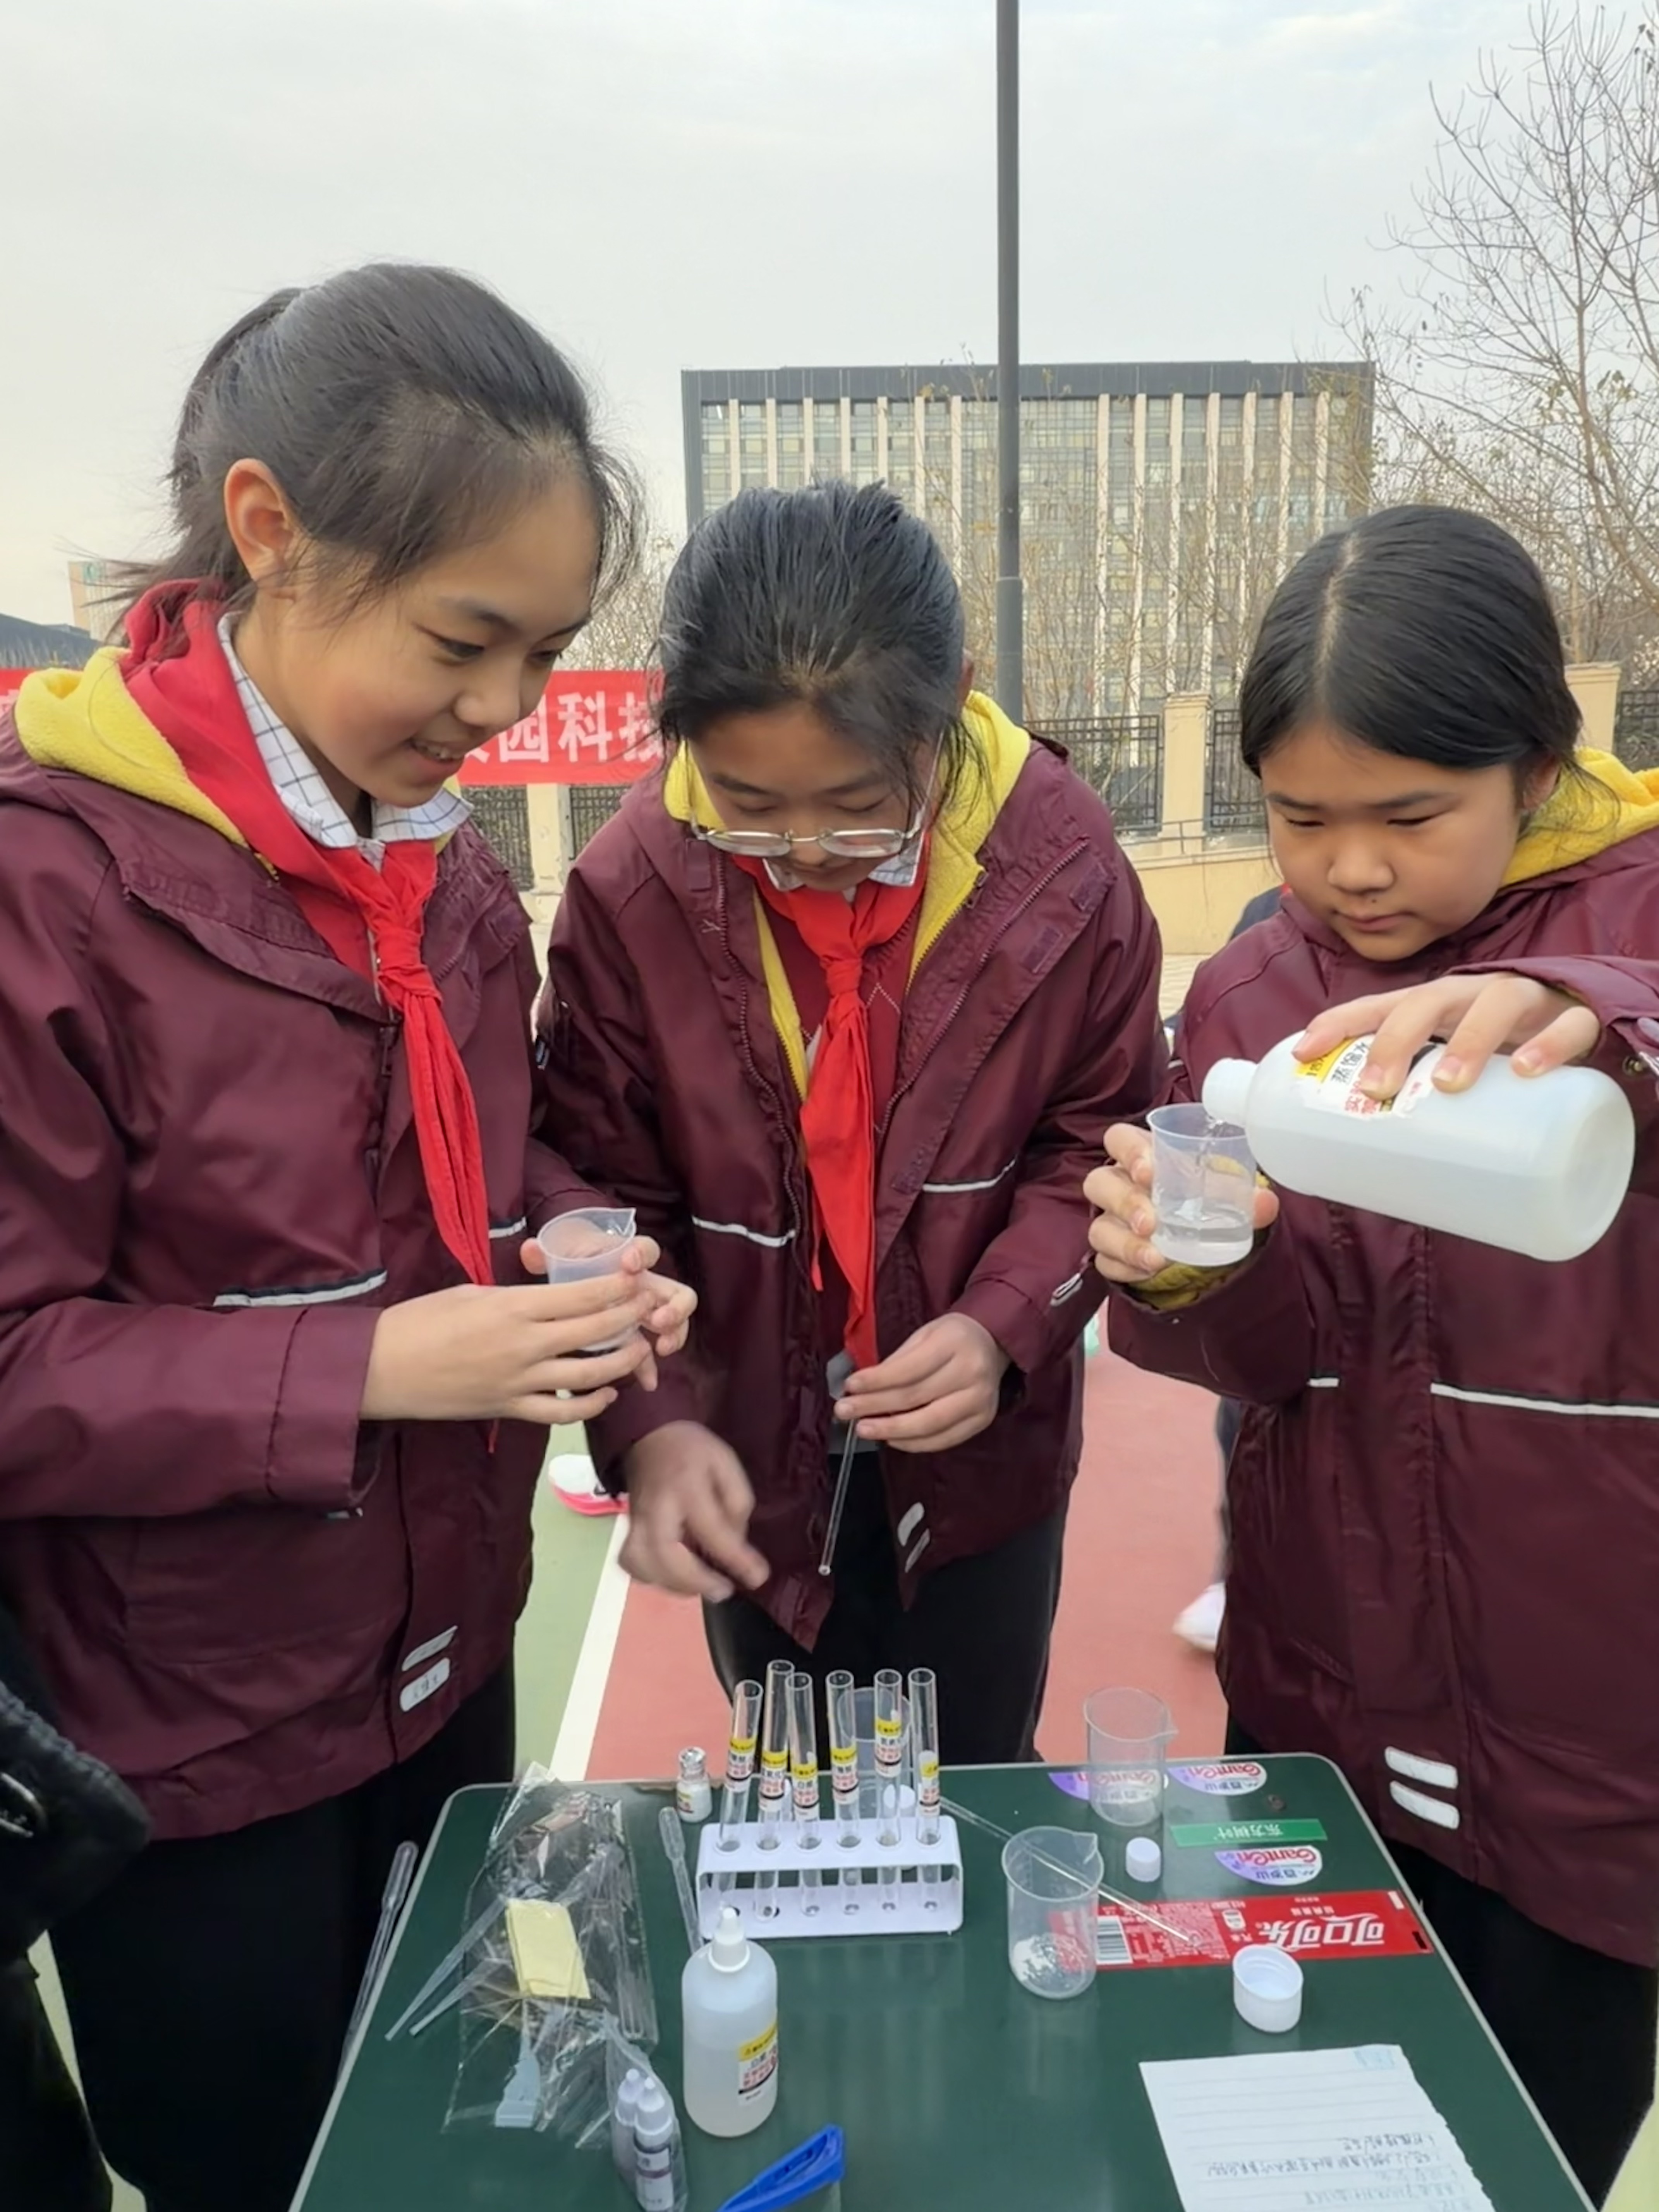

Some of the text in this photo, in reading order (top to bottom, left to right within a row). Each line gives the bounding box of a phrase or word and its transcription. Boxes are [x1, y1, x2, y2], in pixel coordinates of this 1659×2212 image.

[465, 690, 663, 763] 园科技
[1217, 1824, 1283, 1839] 东方树叶
[1259, 1913, 1385, 1952] 可口可乐
